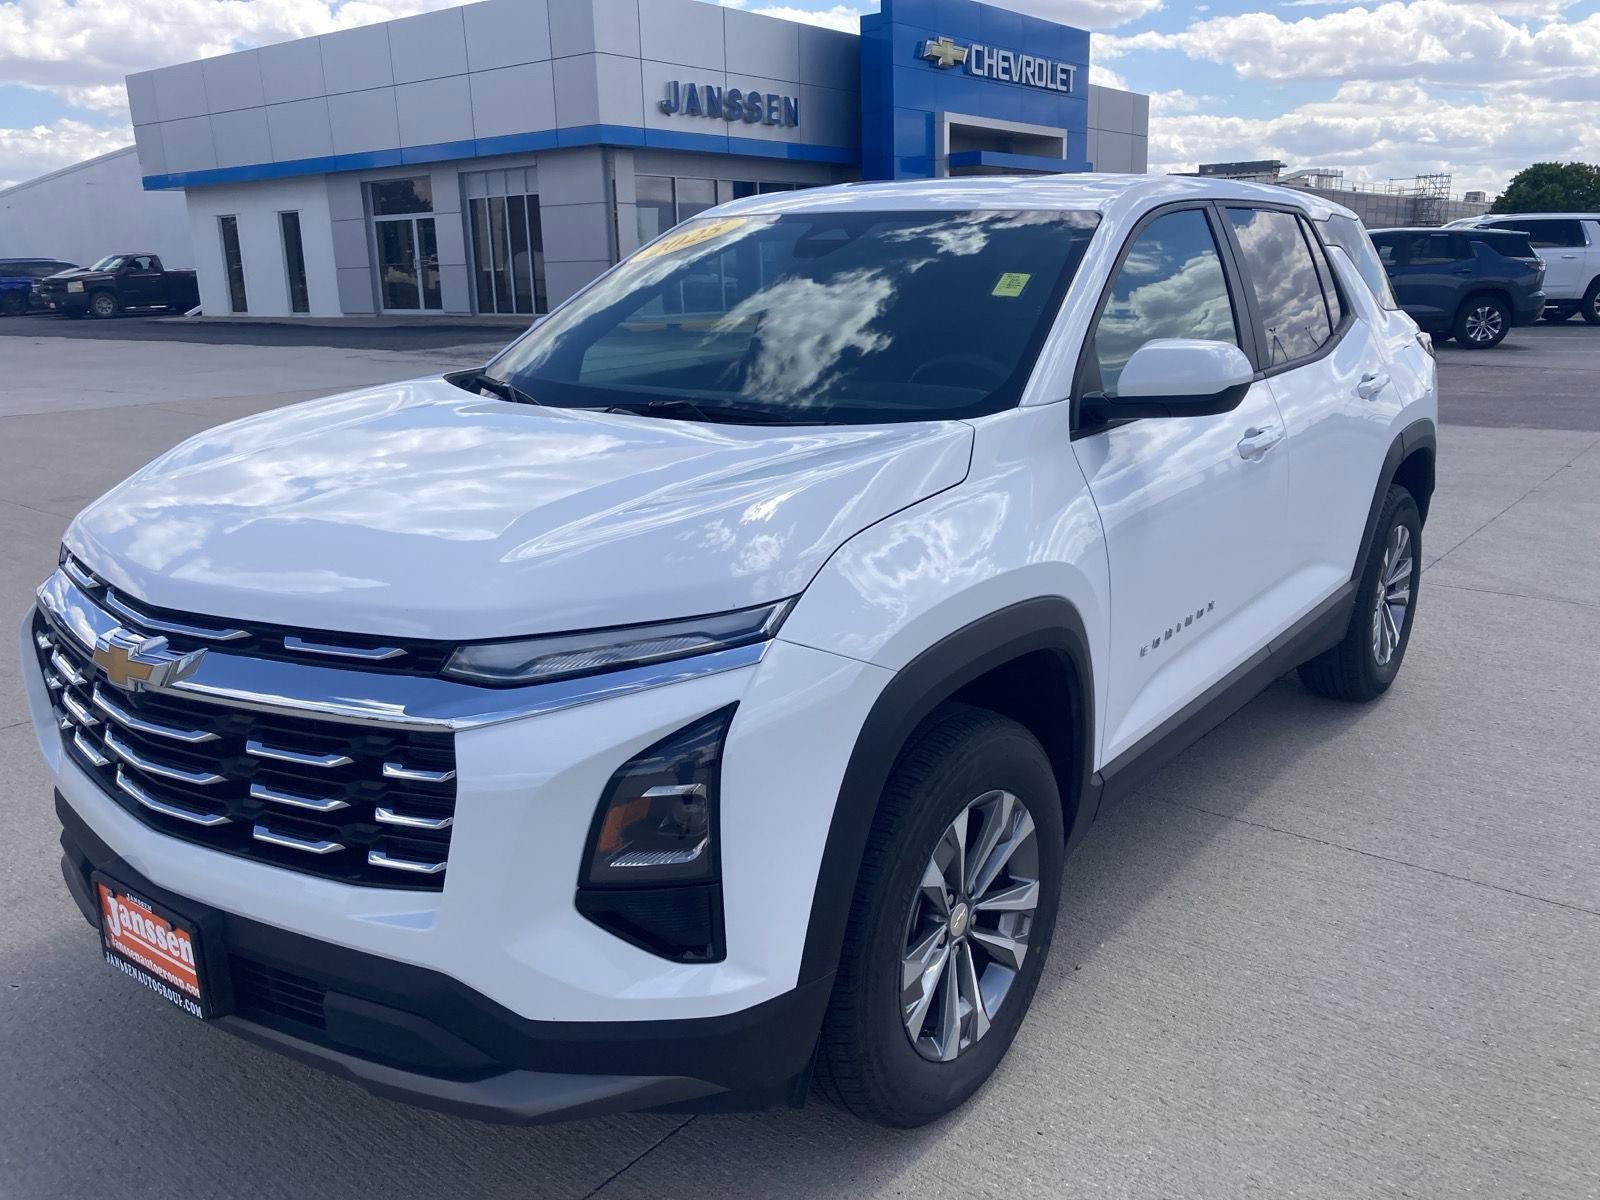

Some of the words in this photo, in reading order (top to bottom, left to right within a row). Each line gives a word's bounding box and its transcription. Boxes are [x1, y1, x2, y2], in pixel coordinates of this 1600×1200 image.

[971, 43, 1077, 93] CHEVROLET
[658, 80, 799, 128] JANSSEN
[107, 896, 195, 966] Janssen
[106, 952, 203, 1020] JANSSENAUTOGROUP.COM
